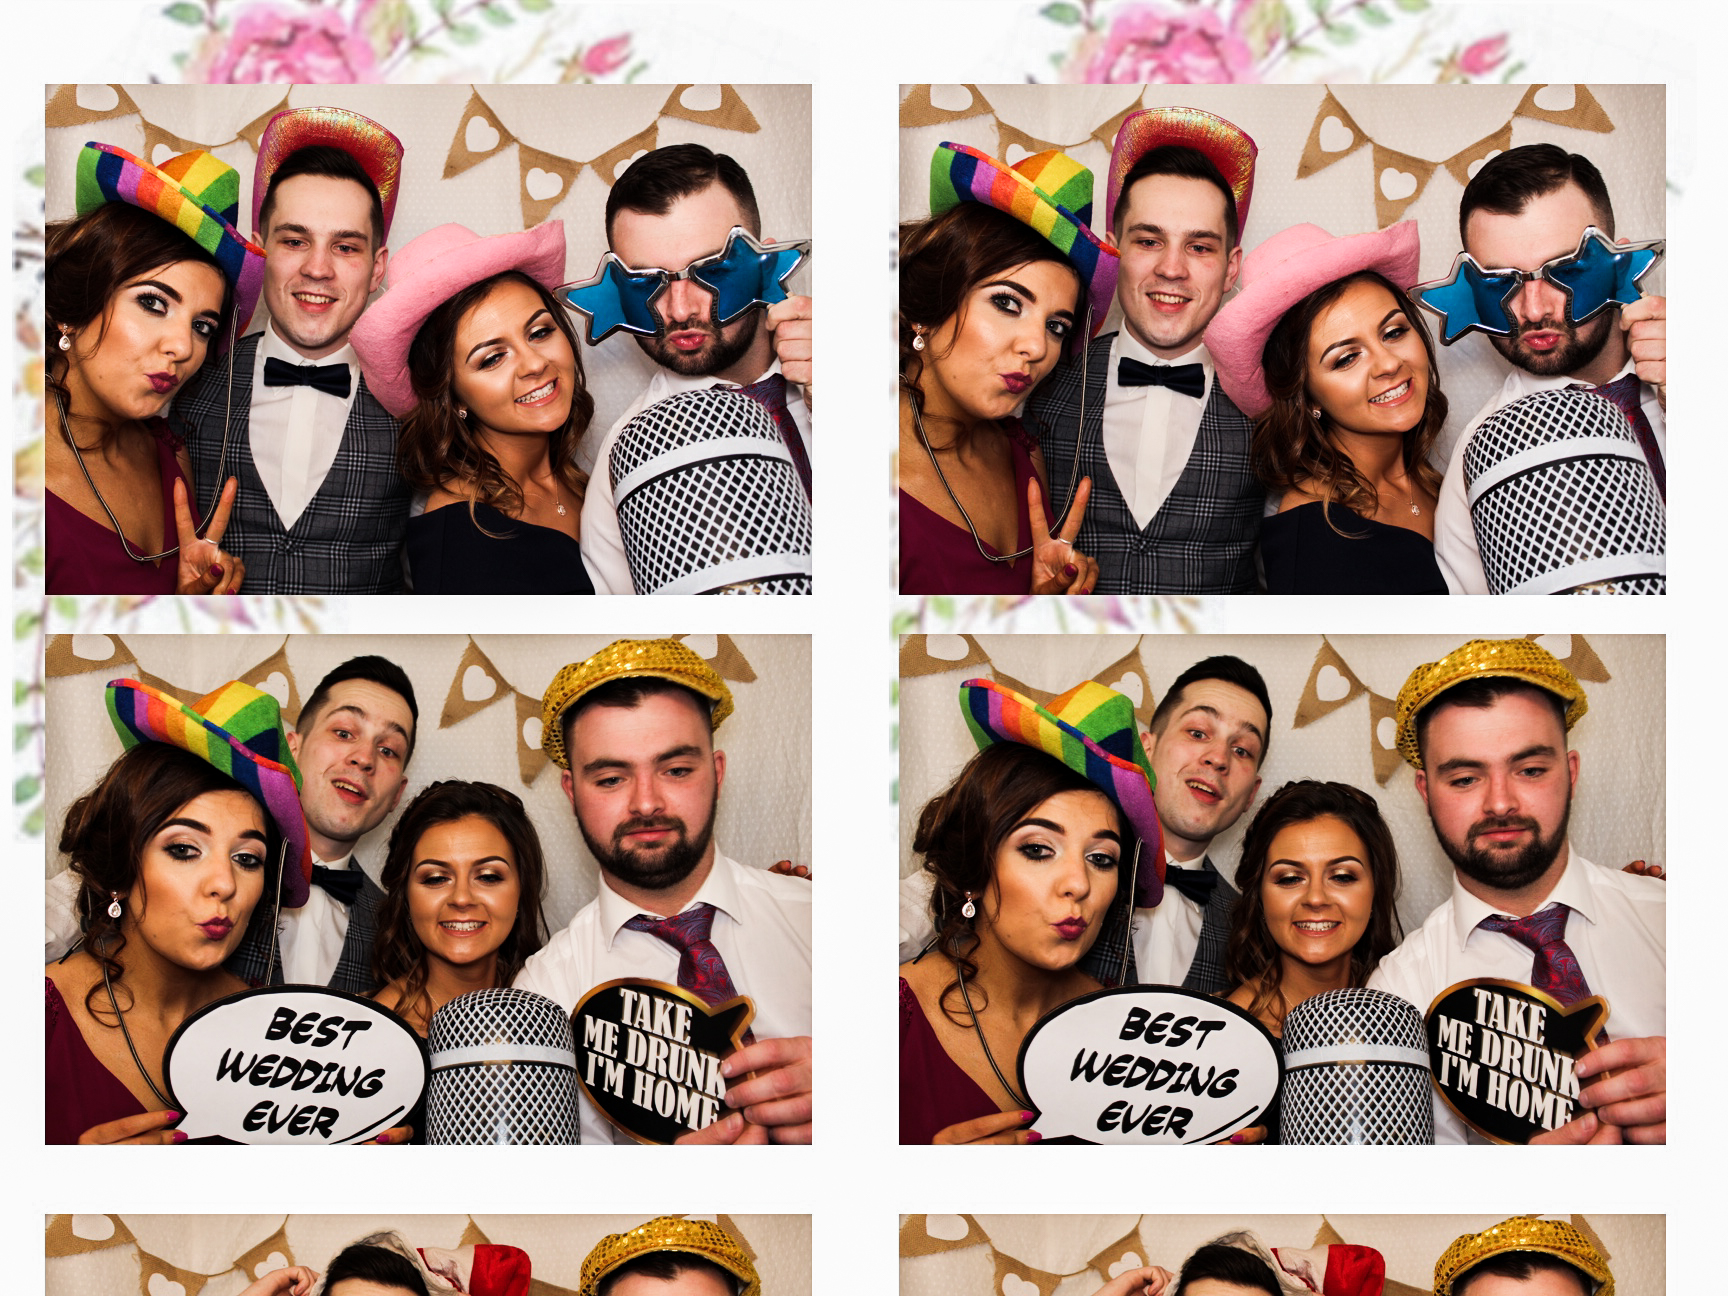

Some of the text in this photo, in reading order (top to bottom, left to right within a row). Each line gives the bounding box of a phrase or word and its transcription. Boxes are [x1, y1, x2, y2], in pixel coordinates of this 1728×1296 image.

[265, 1006, 372, 1050] BEST
[619, 987, 693, 1045] TAKE
[1119, 1006, 1226, 1050] BEST
[1473, 987, 1547, 1045] TAKE
[216, 1048, 385, 1098] WEDDING
[583, 1014, 727, 1100] ME DRUNK
[1070, 1048, 1239, 1098] WEDDING
[1437, 1014, 1581, 1100] ME DRUNK
[585, 1041, 720, 1131] I'M HOME
[1439, 1041, 1574, 1131] I'M HOME
[243, 1100, 339, 1139] EVER
[1097, 1100, 1193, 1139] EVER
